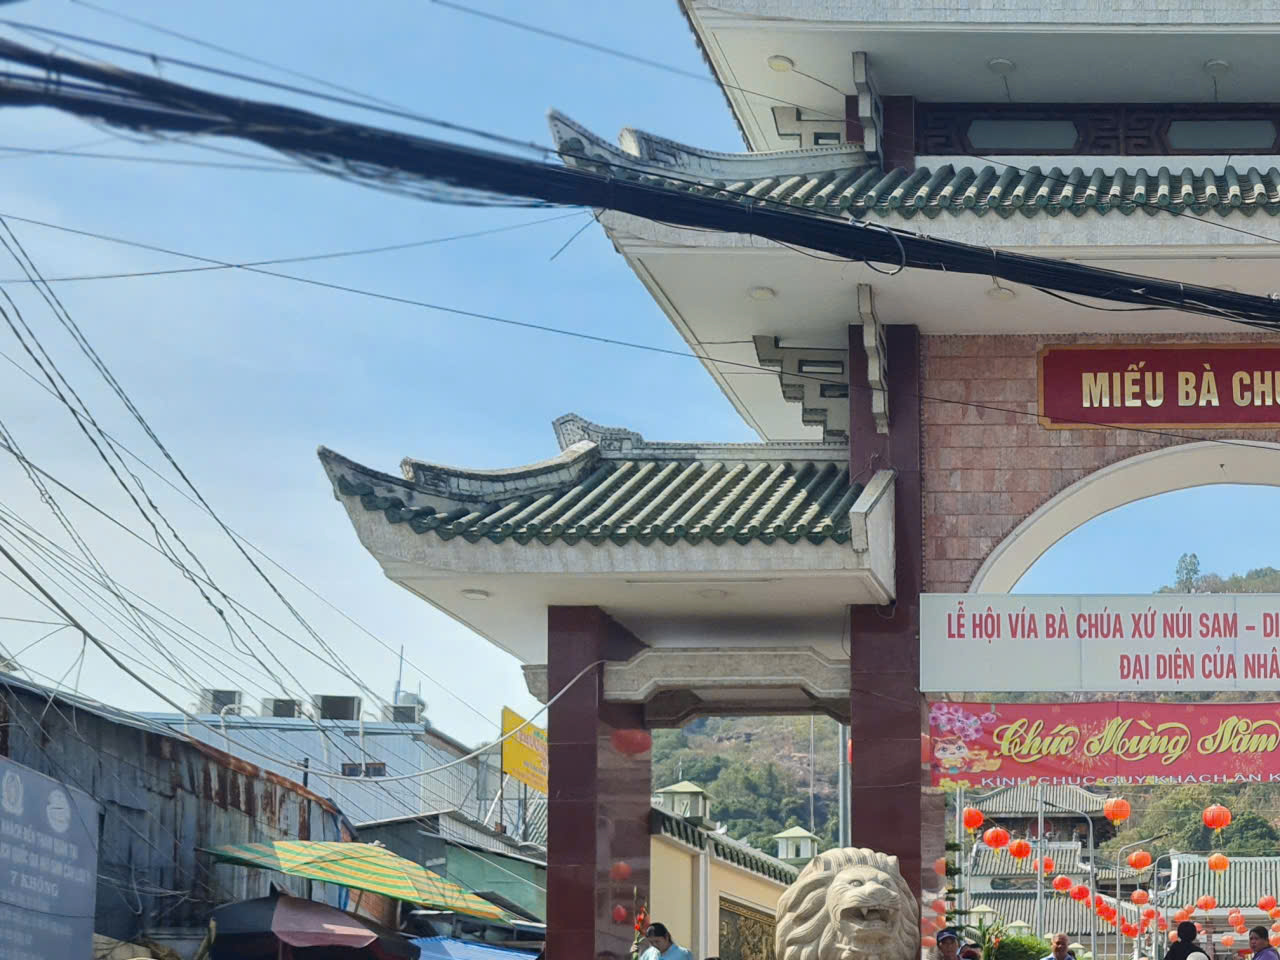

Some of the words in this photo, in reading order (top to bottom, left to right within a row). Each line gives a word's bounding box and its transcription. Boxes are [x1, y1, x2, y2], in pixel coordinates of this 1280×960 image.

[1082, 361, 1164, 407] MIẾU
[1178, 363, 1220, 407] BÀ
[947, 601, 965, 639] LỄ
[972, 606, 1000, 644] HỘI
[1008, 606, 1038, 639] VÍA
[1045, 606, 1069, 639] BÀ
[1076, 606, 1124, 639] CHÚA
[1131, 606, 1157, 639] XỨ
[1162, 606, 1192, 639] NÚI
[1199, 613, 1238, 639] SAM
[1263, 612, 1279, 638] DI
[1119, 653, 1150, 685] ĐẠI
[1156, 647, 1195, 685] DIỆN
[1201, 645, 1237, 680] CỦA
[992, 718, 1081, 764] Chúc
[1083, 715, 1192, 765] Mừng
